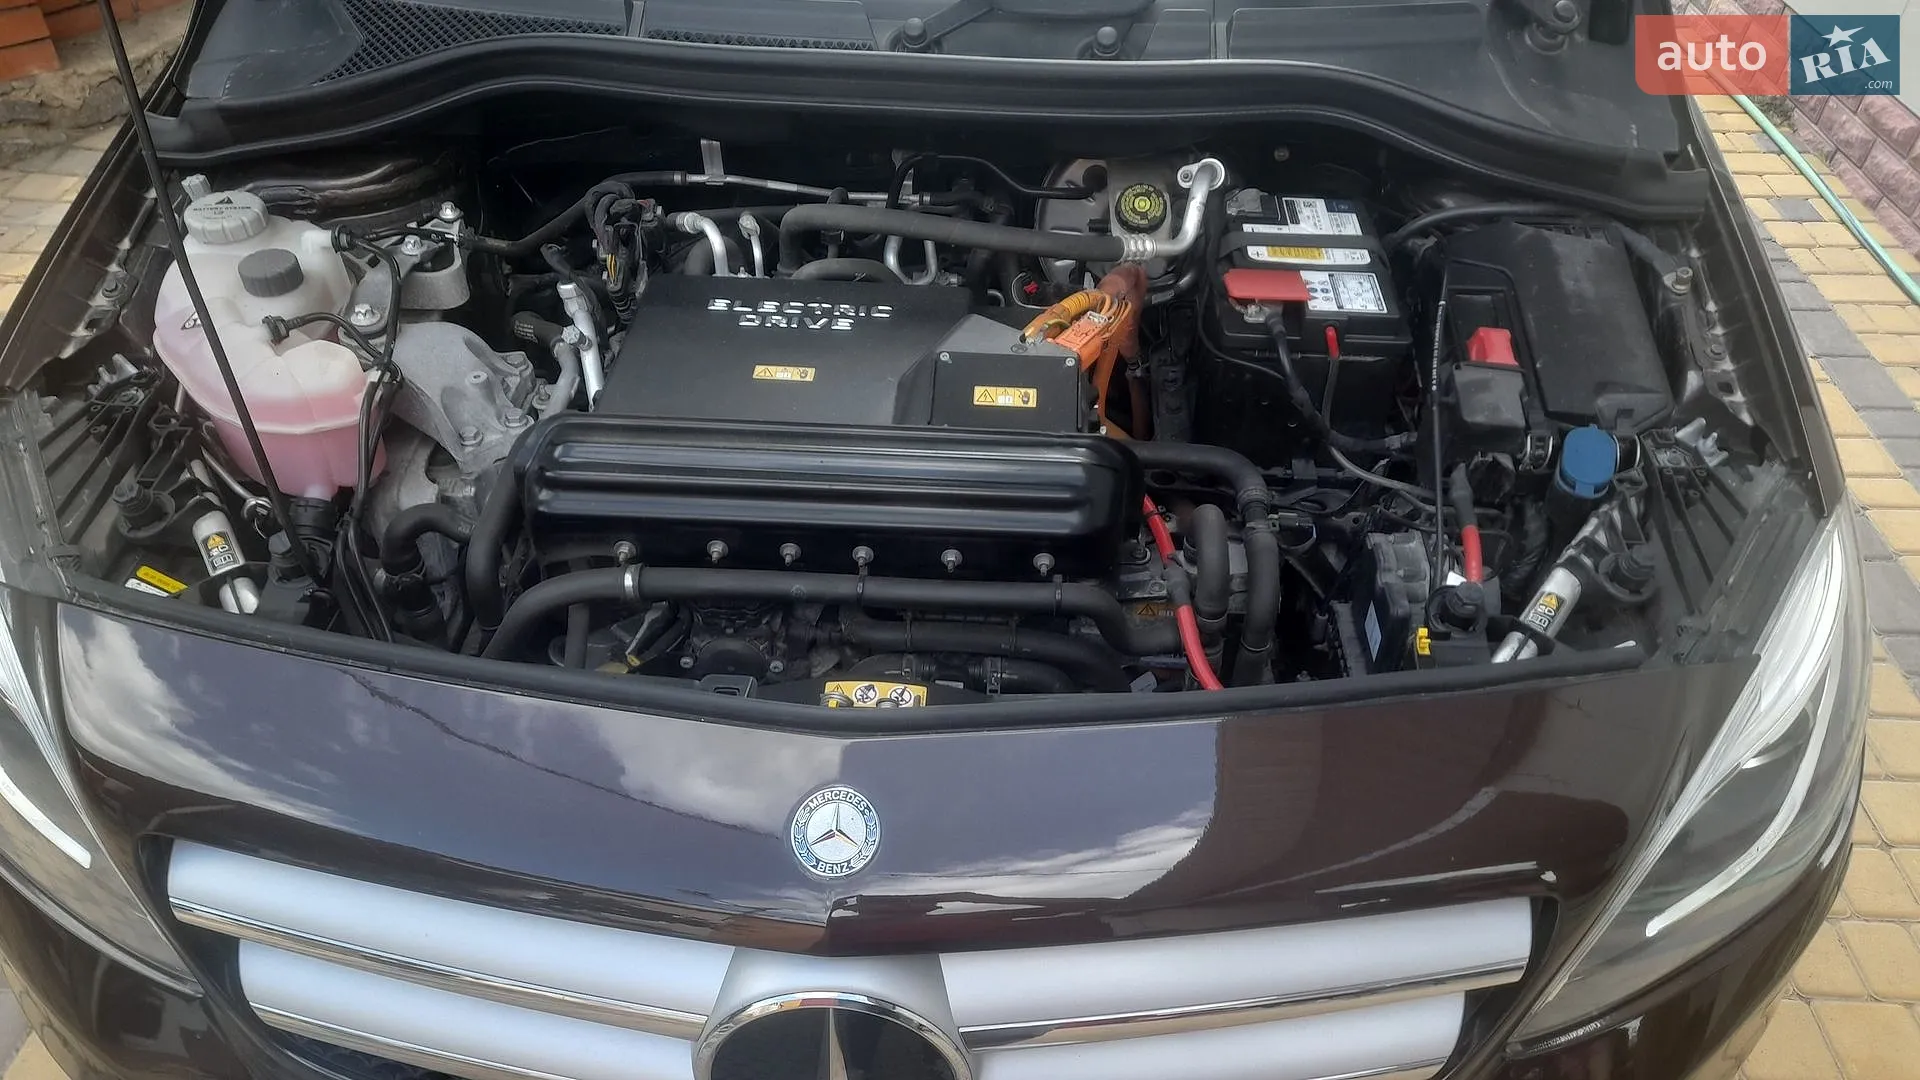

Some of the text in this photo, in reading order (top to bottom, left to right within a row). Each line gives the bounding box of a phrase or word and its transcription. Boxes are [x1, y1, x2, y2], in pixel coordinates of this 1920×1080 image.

[707, 298, 892, 318] ELECTRIC
[738, 314, 854, 330] DRIVE
[808, 790, 867, 810] MERCEDES
[817, 862, 850, 874] BENZ
